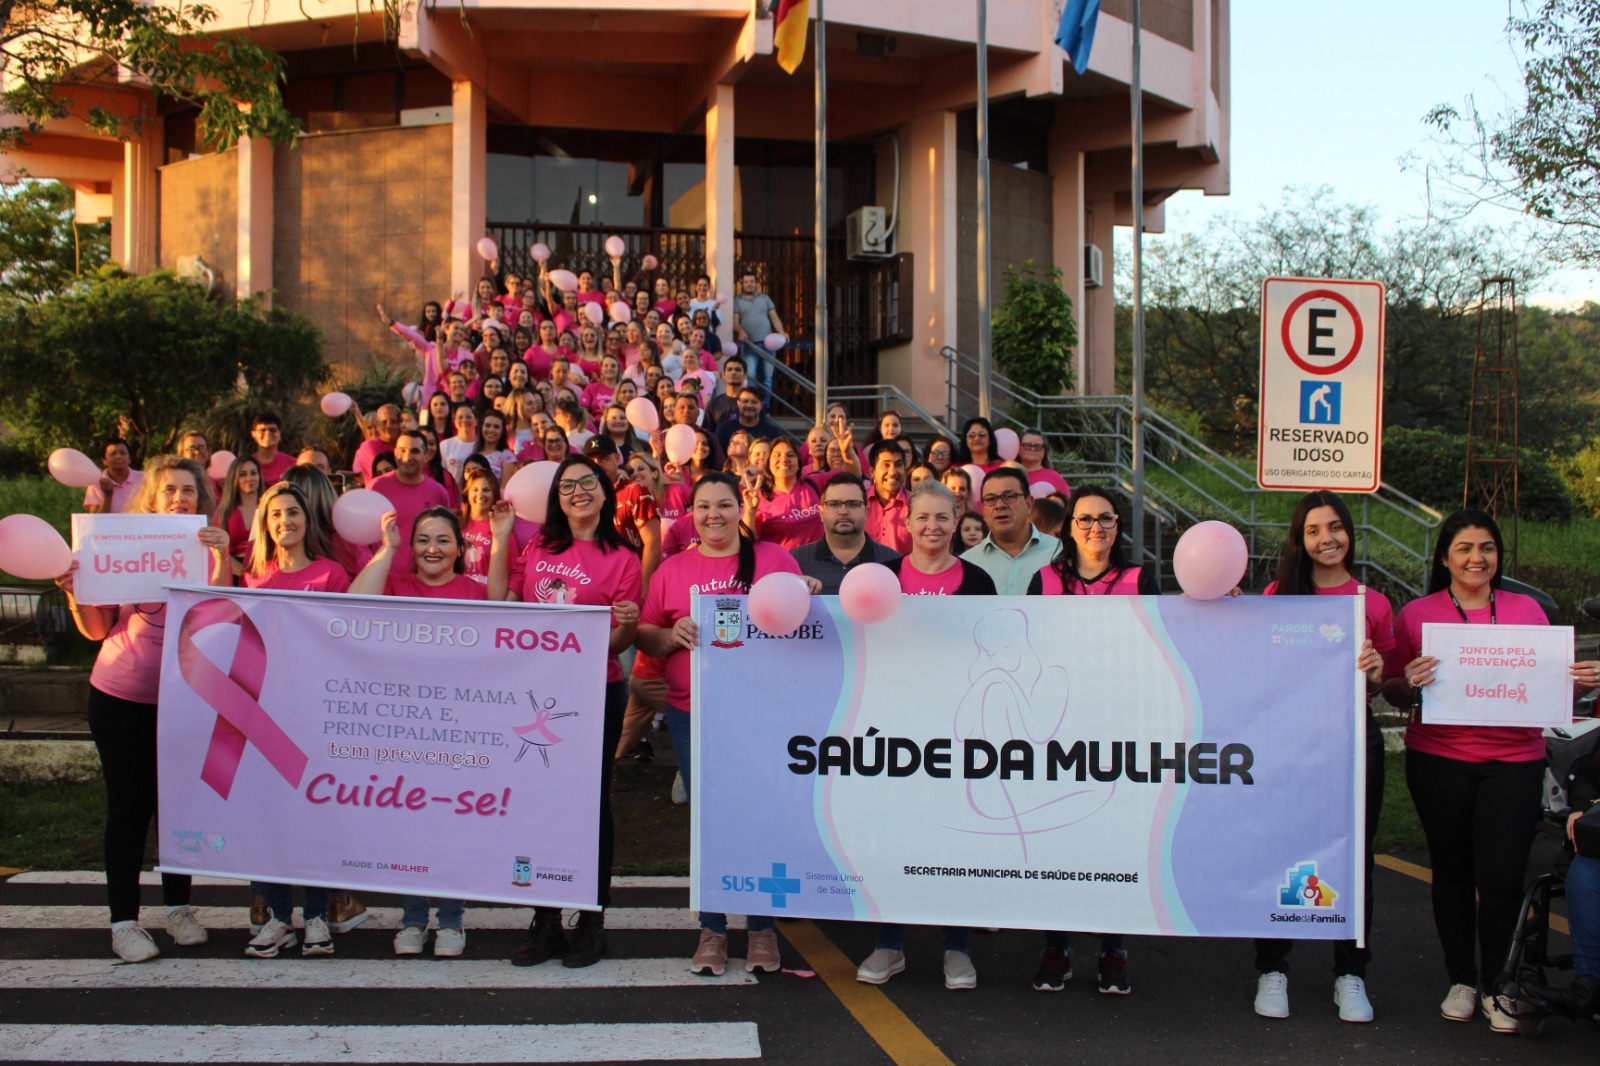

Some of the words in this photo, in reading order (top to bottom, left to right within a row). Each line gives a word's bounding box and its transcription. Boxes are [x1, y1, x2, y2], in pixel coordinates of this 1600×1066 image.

[1307, 308, 1337, 357] E
[1269, 428, 1369, 445] RESERVADO
[1293, 447, 1344, 463] IDOSO
[1264, 468, 1280, 477] USO
[1281, 468, 1329, 478] OBRIGATÓRIO
[1330, 470, 1341, 479] DO
[1342, 469, 1373, 480] CARTÃO
[143, 533, 188, 542] PREVENÇÃO
[535, 560, 592, 585] Outubro
[326, 616, 480, 648] OUTUBRO
[495, 627, 582, 654] ROSA
[1271, 622, 1315, 633] PAROBÉ
[1459, 646, 1504, 656] JUNTOS
[1507, 647, 1537, 656] PELA
[1459, 656, 1537, 670] PREVENÇÃO
[325, 677, 412, 698] CÂNCER
[417, 685, 447, 700] DE
[453, 687, 517, 705] MAMA
[323, 699, 369, 716] TEM
[375, 703, 433, 721] CURA
[440, 707, 459, 725] E,
[323, 720, 510, 749] PRINCIPALMENTE,
[328, 740, 371, 758] tem
[376, 746, 492, 771] prevenção
[786, 725, 952, 779] SAÚDE
[963, 738, 1034, 781] DA
[1046, 739, 1255, 786] MULHER
[305, 772, 512, 817] Cuide-se!
[341, 859, 373, 869] SAÚDE
[376, 862, 390, 870] DA
[390, 863, 430, 874] MULHER
[903, 865, 967, 877] SECRETARIA
[968, 867, 1023, 880] MUNICIPAL
[1024, 870, 1039, 880] DE
[1041, 869, 1076, 881] SAÚDE
[1077, 871, 1092, 882] DE
[1094, 872, 1139, 884] PAROBÉ
[536, 872, 574, 883] PAROBÉ
[721, 875, 756, 892] SUS
[805, 871, 838, 881] Sistema
[816, 886, 827, 894] de
[829, 886, 857, 896] Saúde
